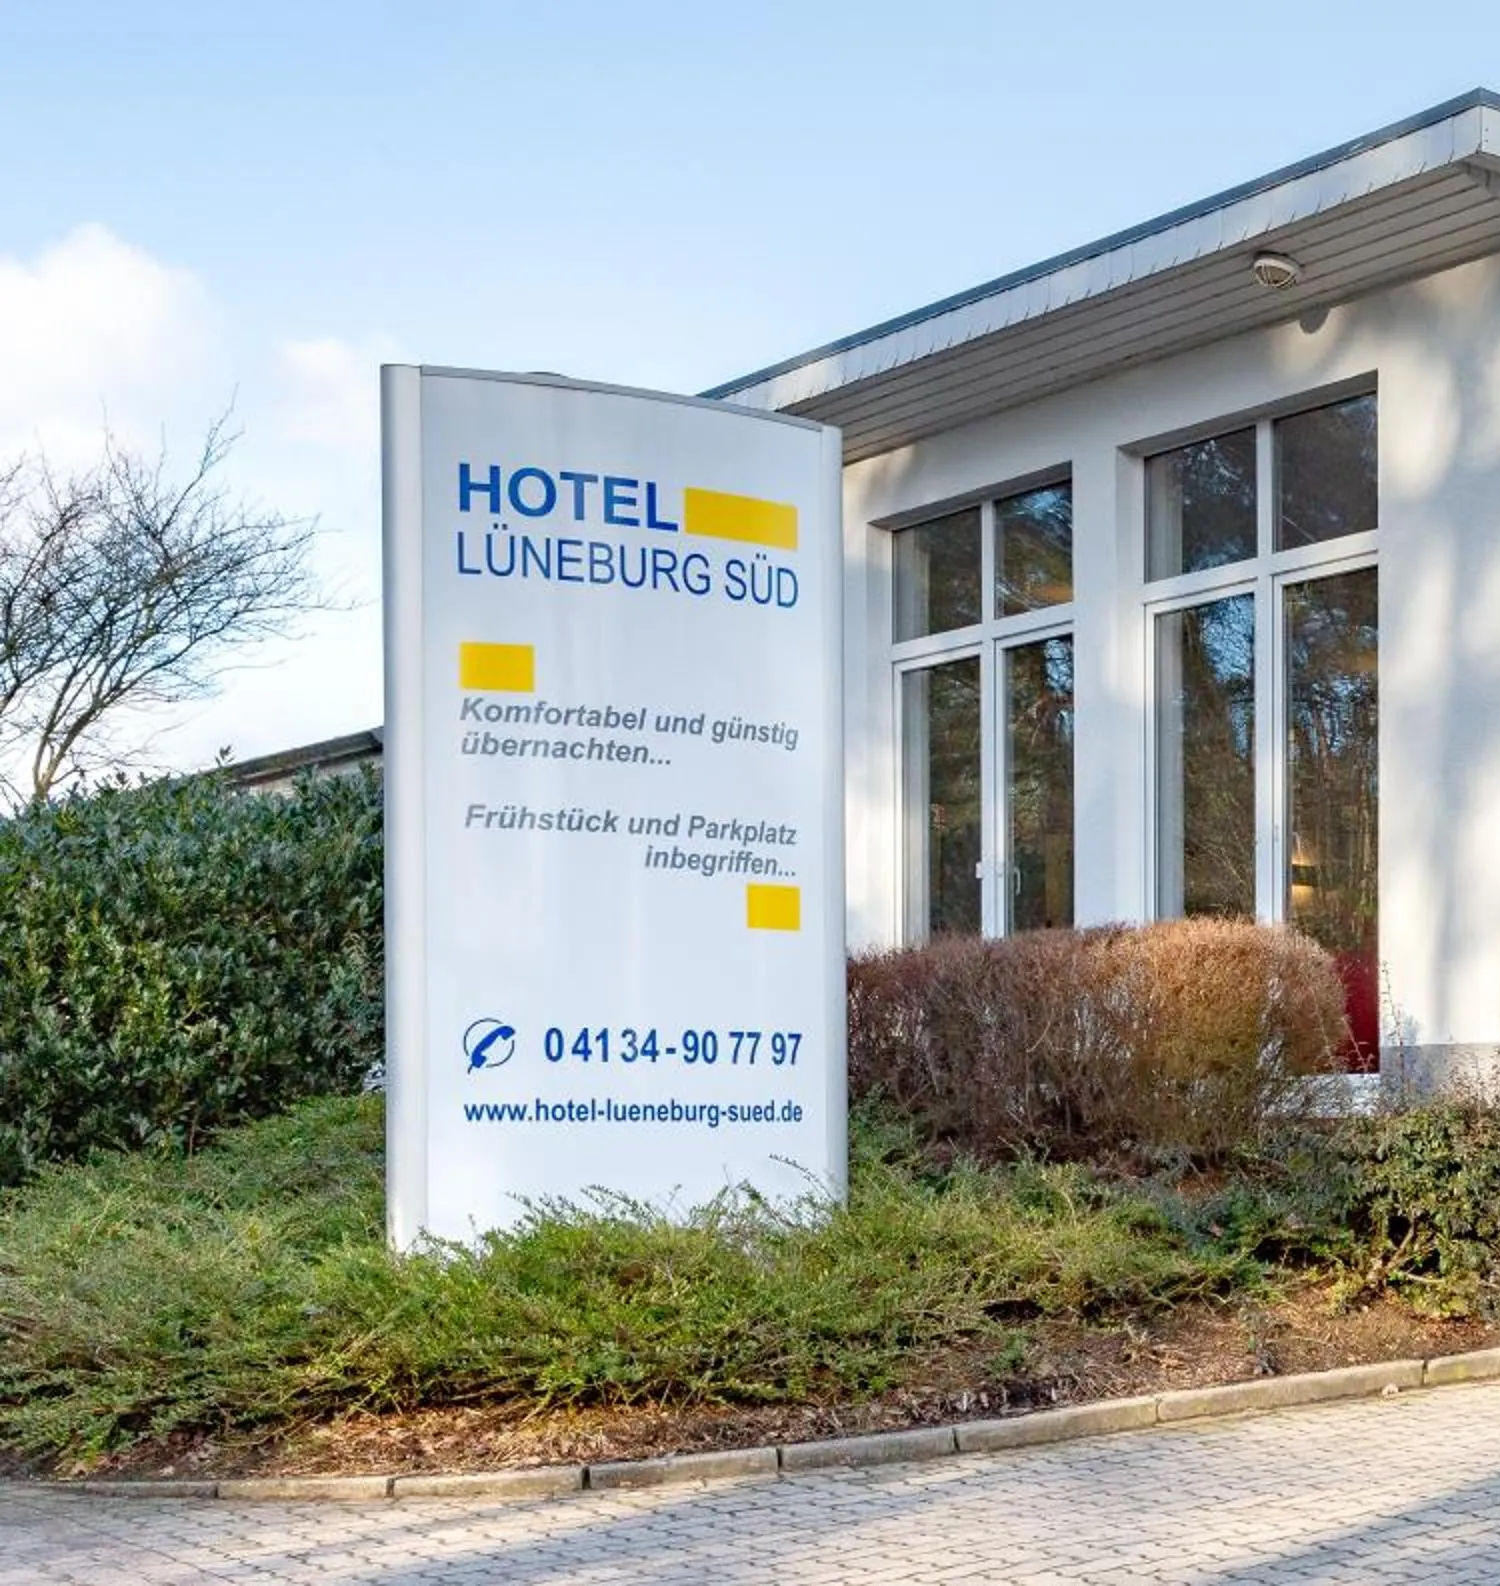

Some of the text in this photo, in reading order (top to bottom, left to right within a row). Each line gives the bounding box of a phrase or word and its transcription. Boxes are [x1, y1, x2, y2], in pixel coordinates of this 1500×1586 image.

[457, 462, 679, 532] HOTEL
[457, 523, 799, 608] LÜNEBURG SÜD
[460, 697, 799, 751] Komfortabel und günstig
[461, 731, 672, 765] übernachten...
[464, 803, 797, 847] Frühstück und Parkplatz
[644, 845, 796, 877] inbegriffen...
[463, 1097, 803, 1129] www.hotel-lueneburg-sued.de
